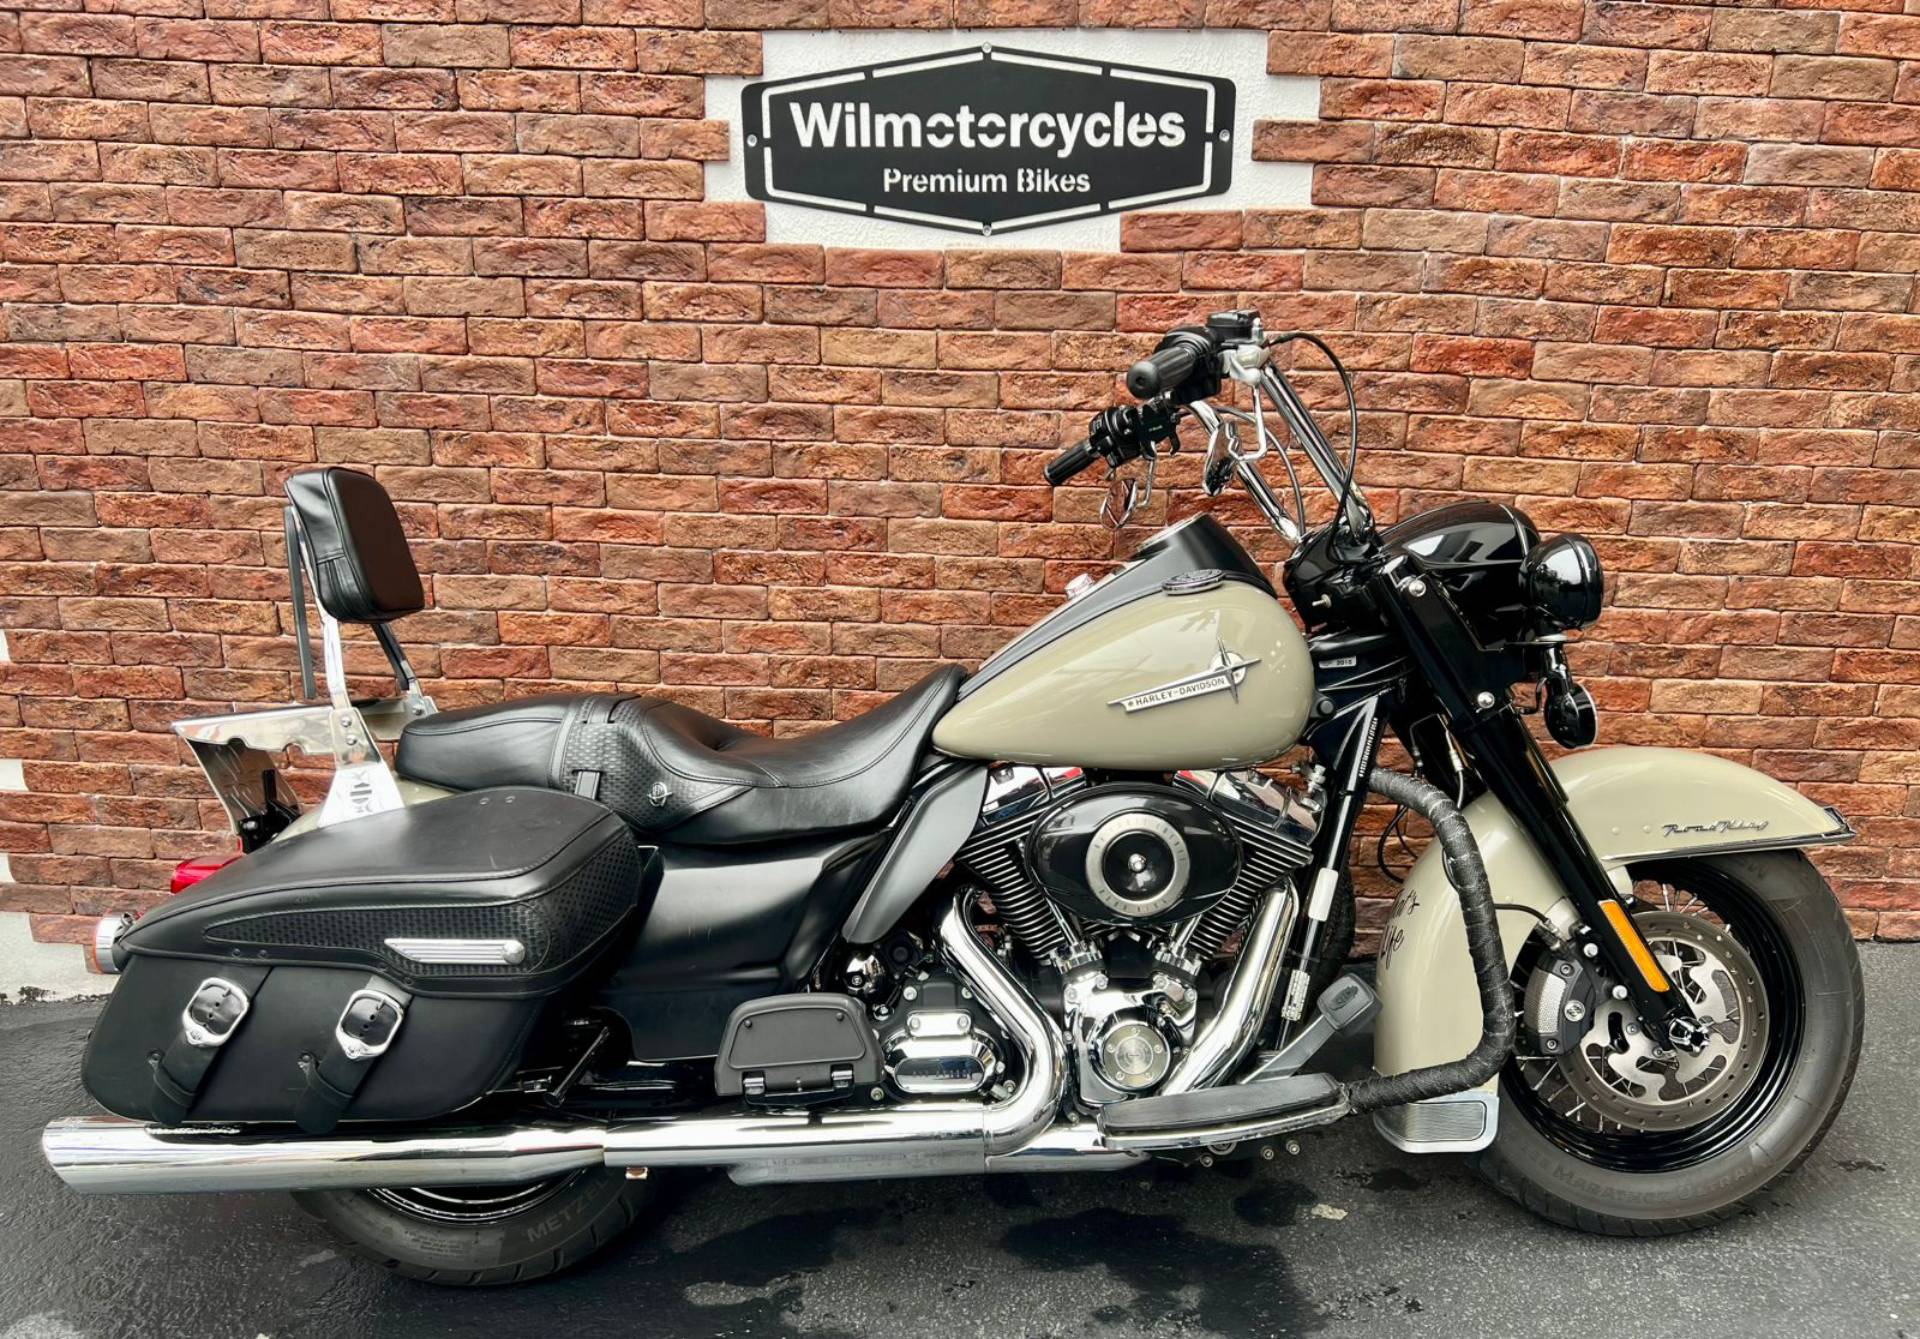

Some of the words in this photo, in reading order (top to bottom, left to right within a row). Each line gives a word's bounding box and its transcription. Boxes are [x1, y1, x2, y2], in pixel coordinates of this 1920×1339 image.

[788, 101, 1187, 158] Wilmotorcycles
[883, 168, 1007, 193] Premium
[1017, 168, 1090, 193] Bikes
[1135, 677, 1225, 706] HARLEY-DAVIDSON
